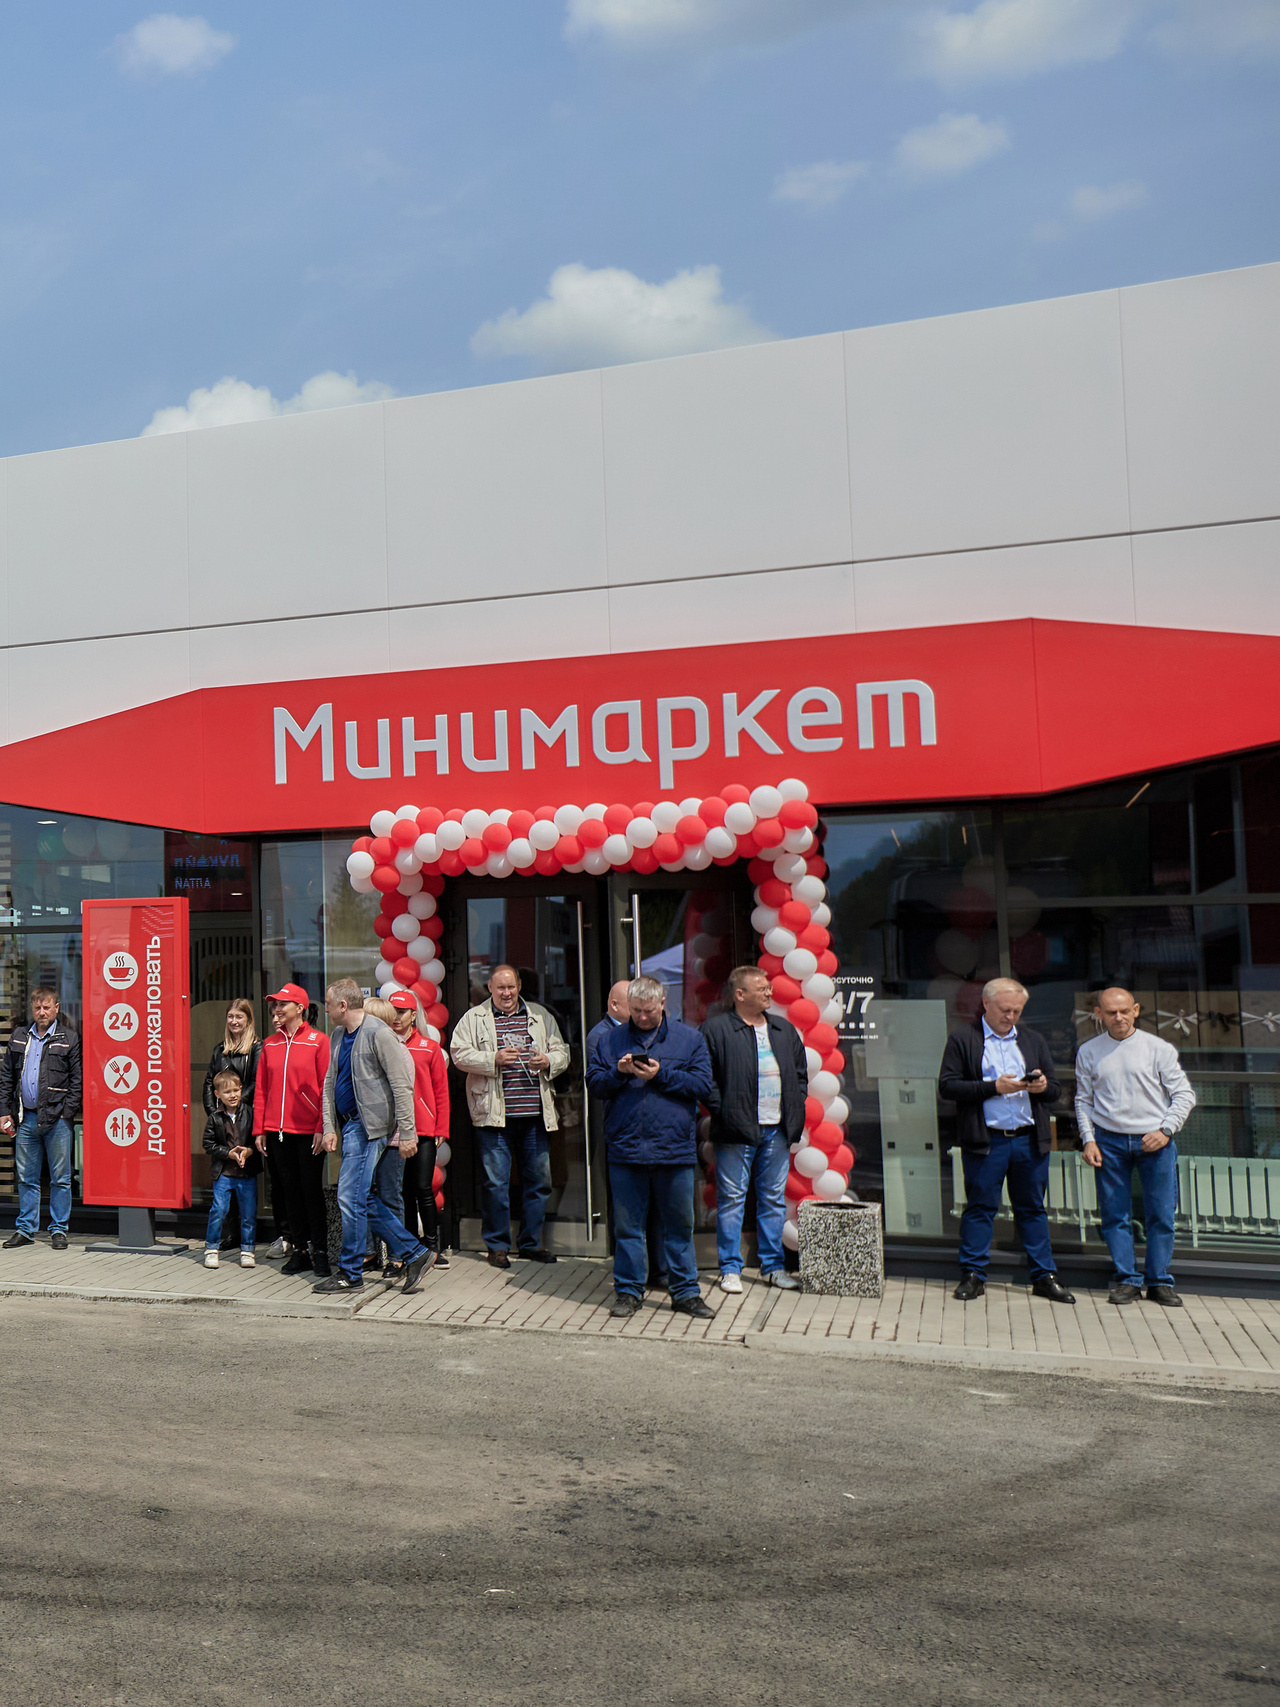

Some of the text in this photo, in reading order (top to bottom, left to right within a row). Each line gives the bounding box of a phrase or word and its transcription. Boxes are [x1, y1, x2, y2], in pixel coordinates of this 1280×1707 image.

[273, 679, 937, 789] Минимаркет
[831, 976, 874, 984] ОСУТОЧНО
[832, 991, 874, 1014] 4/7
[109, 1012, 133, 1030] 24
[143, 936, 166, 1155] добро пожаловать
